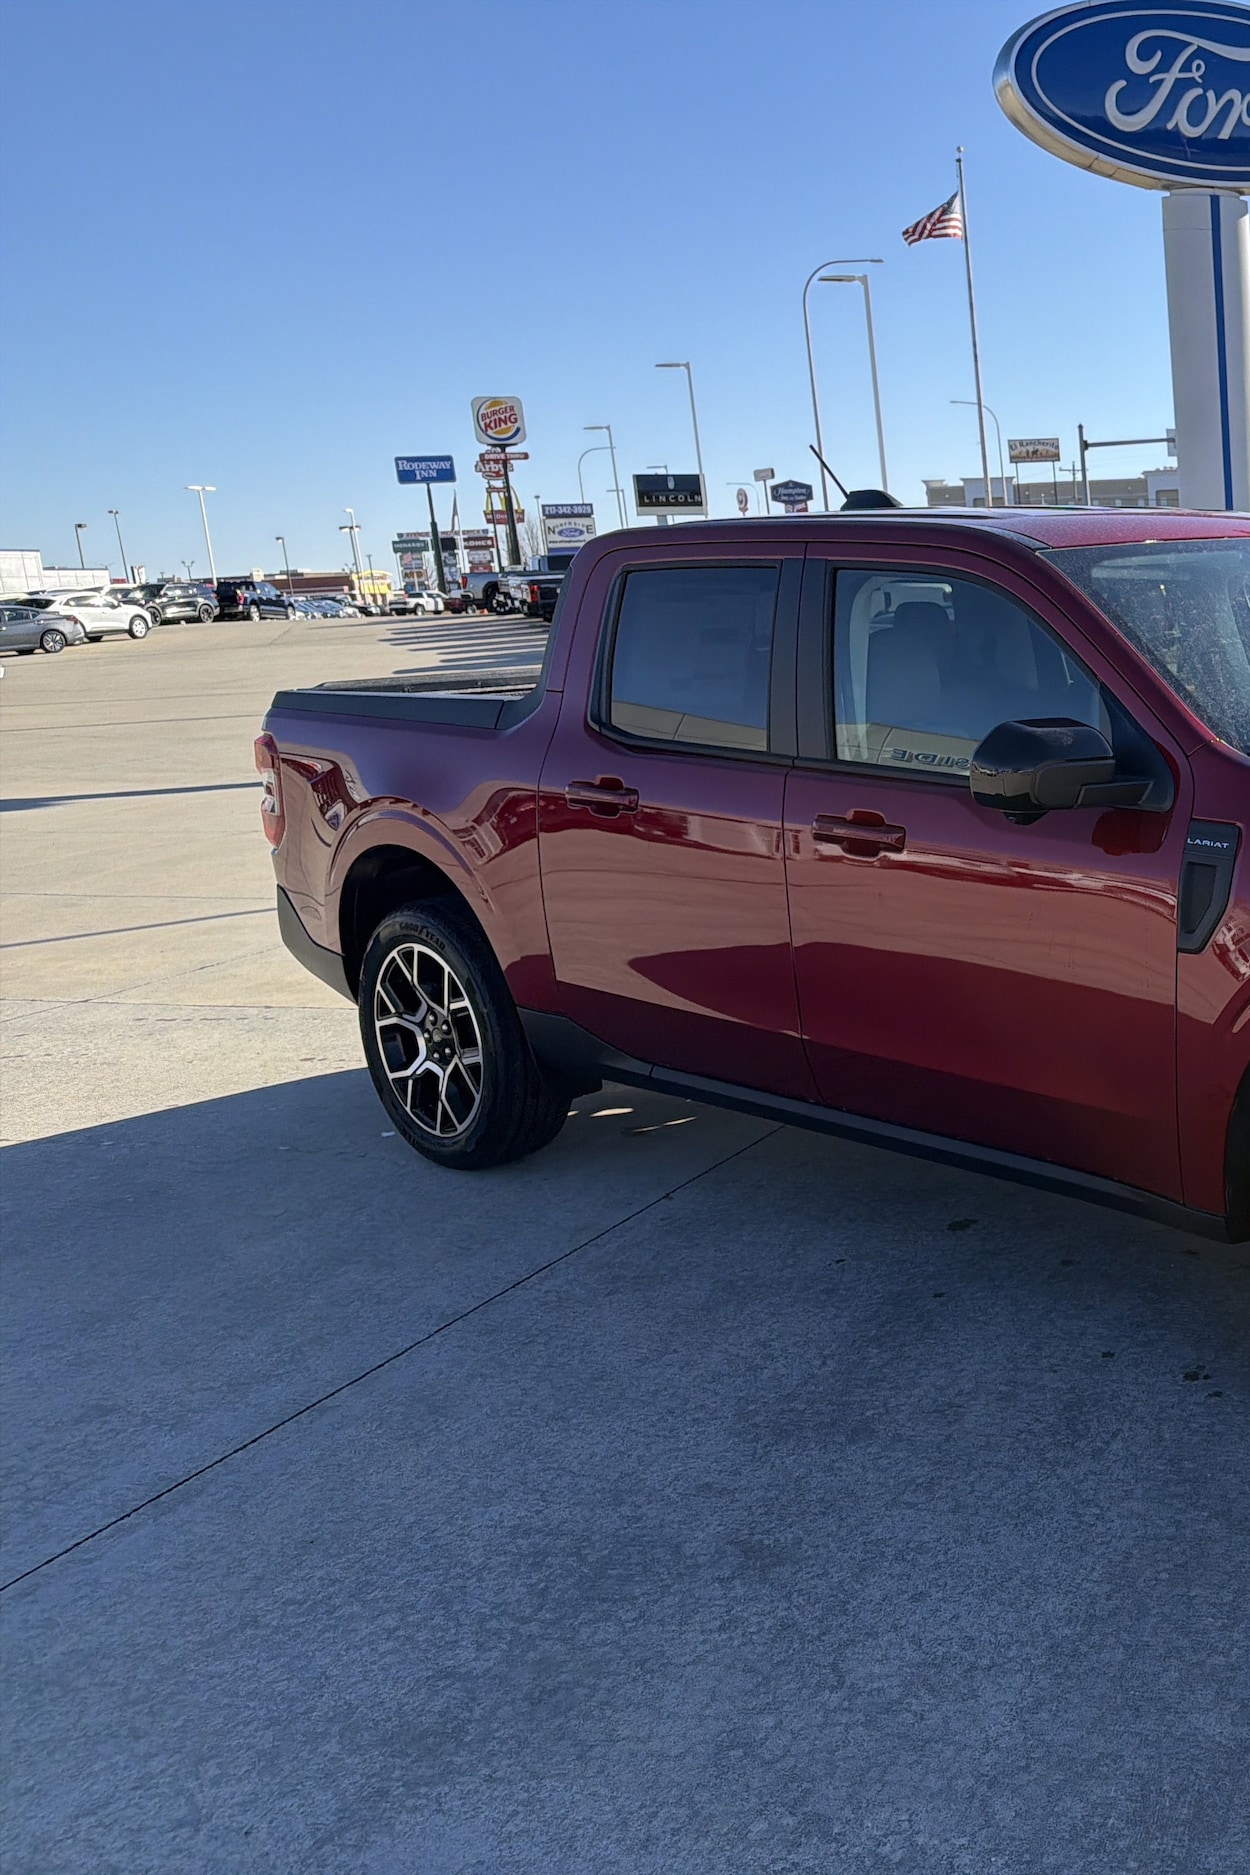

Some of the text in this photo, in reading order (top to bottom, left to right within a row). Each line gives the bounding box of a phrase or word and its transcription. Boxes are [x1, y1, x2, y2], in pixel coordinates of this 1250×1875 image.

[481, 405, 515, 421] BURGER
[484, 413, 518, 432] KING
[397, 460, 451, 470] RODEWAY
[415, 469, 437, 480] INN
[643, 494, 701, 503] LINCOLN
[1187, 838, 1230, 848] LARIAT
